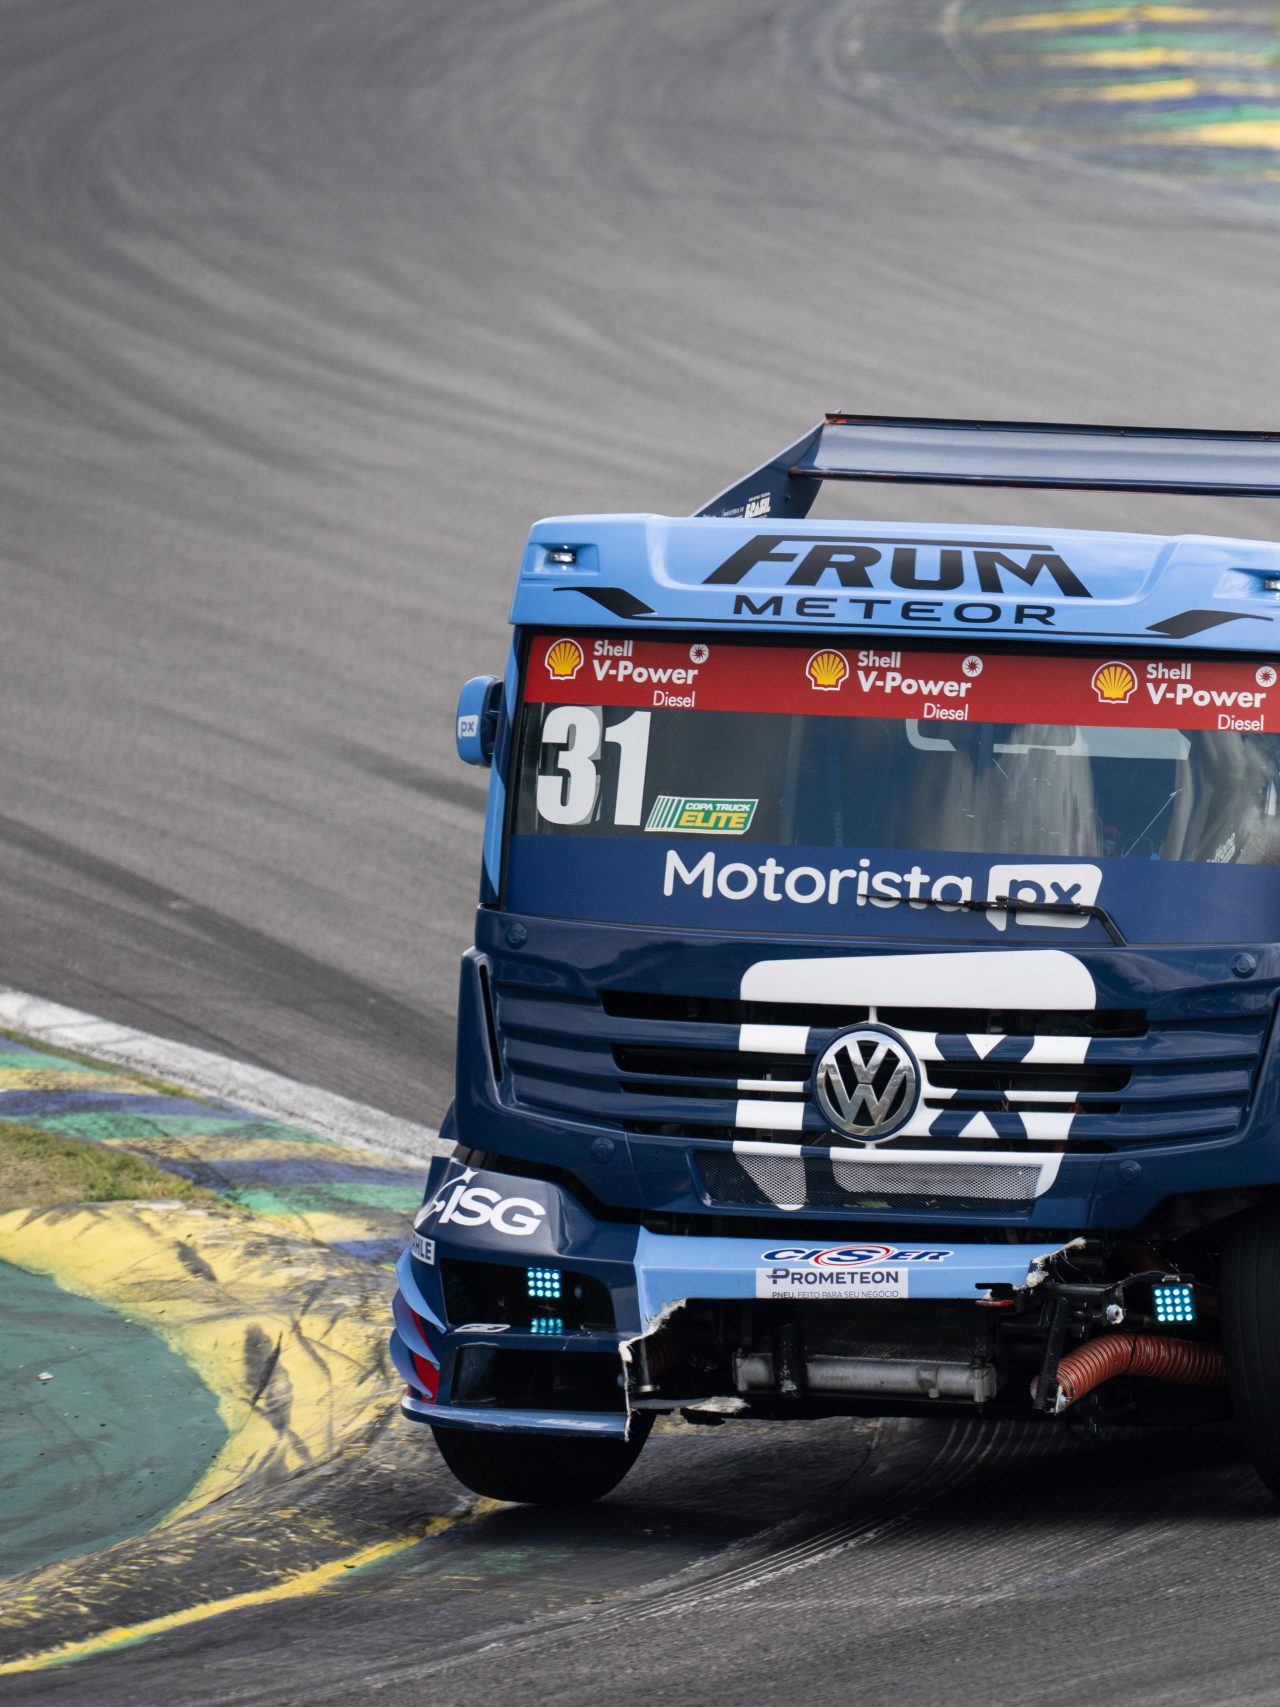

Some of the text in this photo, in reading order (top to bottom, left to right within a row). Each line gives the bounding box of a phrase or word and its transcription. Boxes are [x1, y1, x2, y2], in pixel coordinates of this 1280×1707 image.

[701, 534, 1094, 598] FRUM
[733, 594, 1056, 626] METEOR
[592, 639, 634, 657] Shell
[857, 650, 901, 668] Shell
[592, 659, 699, 685] V-Power
[1146, 662, 1192, 680] Shell
[857, 670, 972, 698] V-Power
[652, 690, 696, 708] Diesel
[1146, 682, 1267, 708] V-Power
[923, 702, 969, 721] Diesel
[1217, 714, 1265, 732] Diesel
[536, 705, 652, 826] 31
[685, 802, 751, 812] COPA TRUCK
[678, 811, 749, 829] ELITE
[663, 849, 974, 912] Motorista
[438, 1185, 546, 1236] ISG
[762, 1246, 953, 1266] CISER
[766, 1267, 899, 1286] PROMETEON
[822, 1291, 843, 1299] PARA
[843, 1291, 861, 1299] SEU
